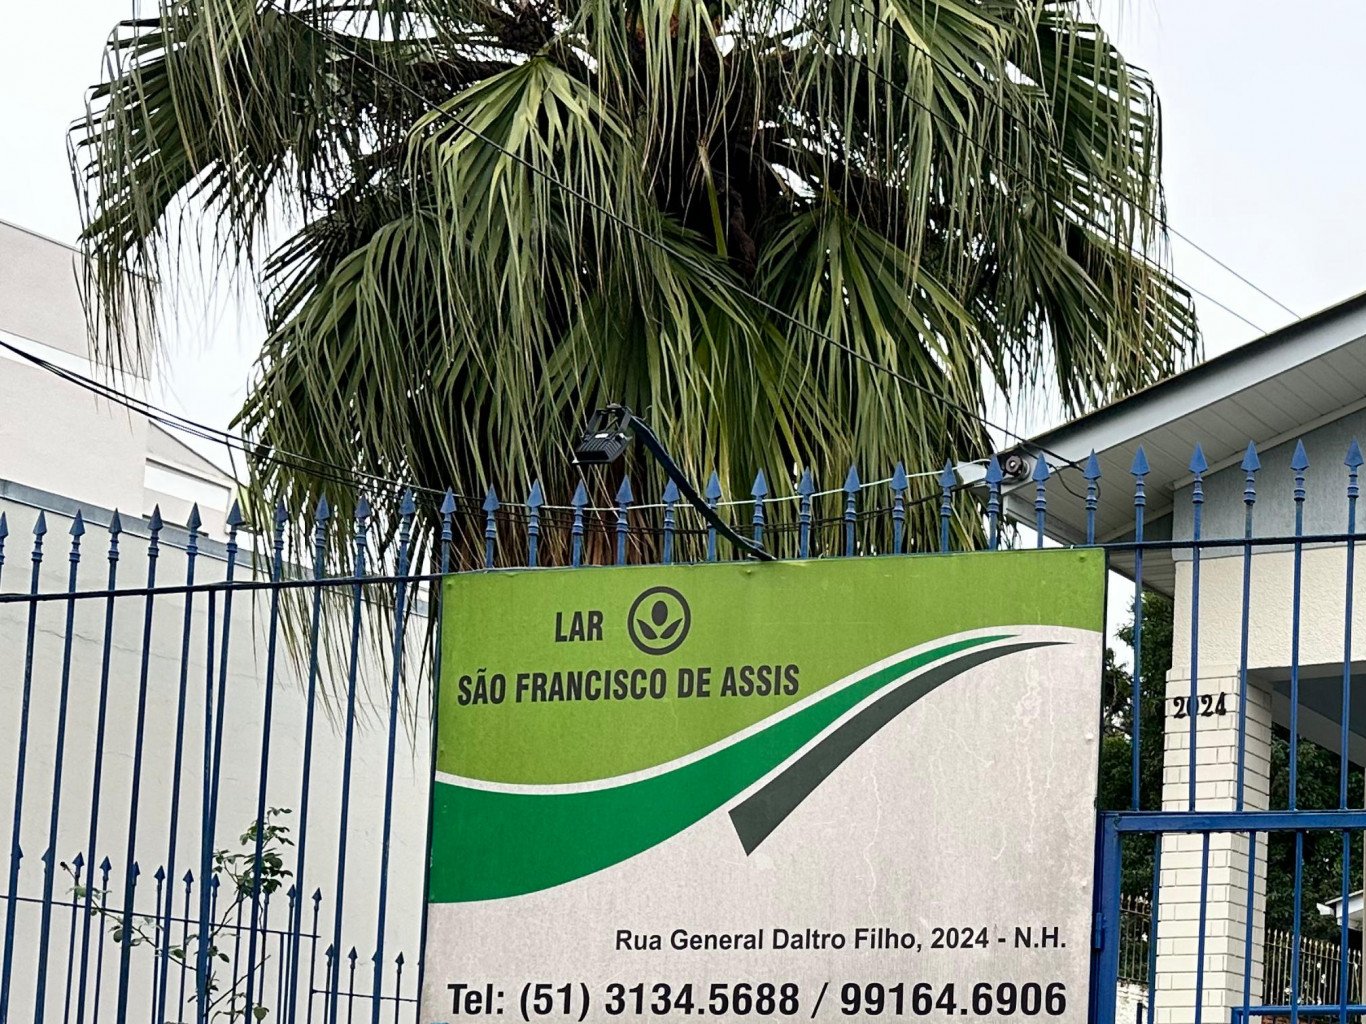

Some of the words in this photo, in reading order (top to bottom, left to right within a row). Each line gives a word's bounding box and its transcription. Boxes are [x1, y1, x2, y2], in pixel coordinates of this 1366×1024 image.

[554, 610, 604, 643] LAR
[457, 667, 507, 707] SÃO
[515, 667, 667, 704] FRANCISCO
[677, 667, 712, 699] DE
[719, 663, 800, 698] ASSIS
[615, 929, 663, 951] Rua
[670, 928, 764, 951] General
[772, 928, 846, 950] Daltro
[854, 927, 923, 954] Filho,
[930, 926, 989, 949] 2024
[1014, 926, 1067, 949] N.H.
[447, 983, 504, 1015] Tel:
[520, 982, 590, 1023] (51)
[605, 982, 800, 1016] 3134.5688
[810, 981, 829, 1019] /
[840, 982, 1067, 1016] 99164.6906
